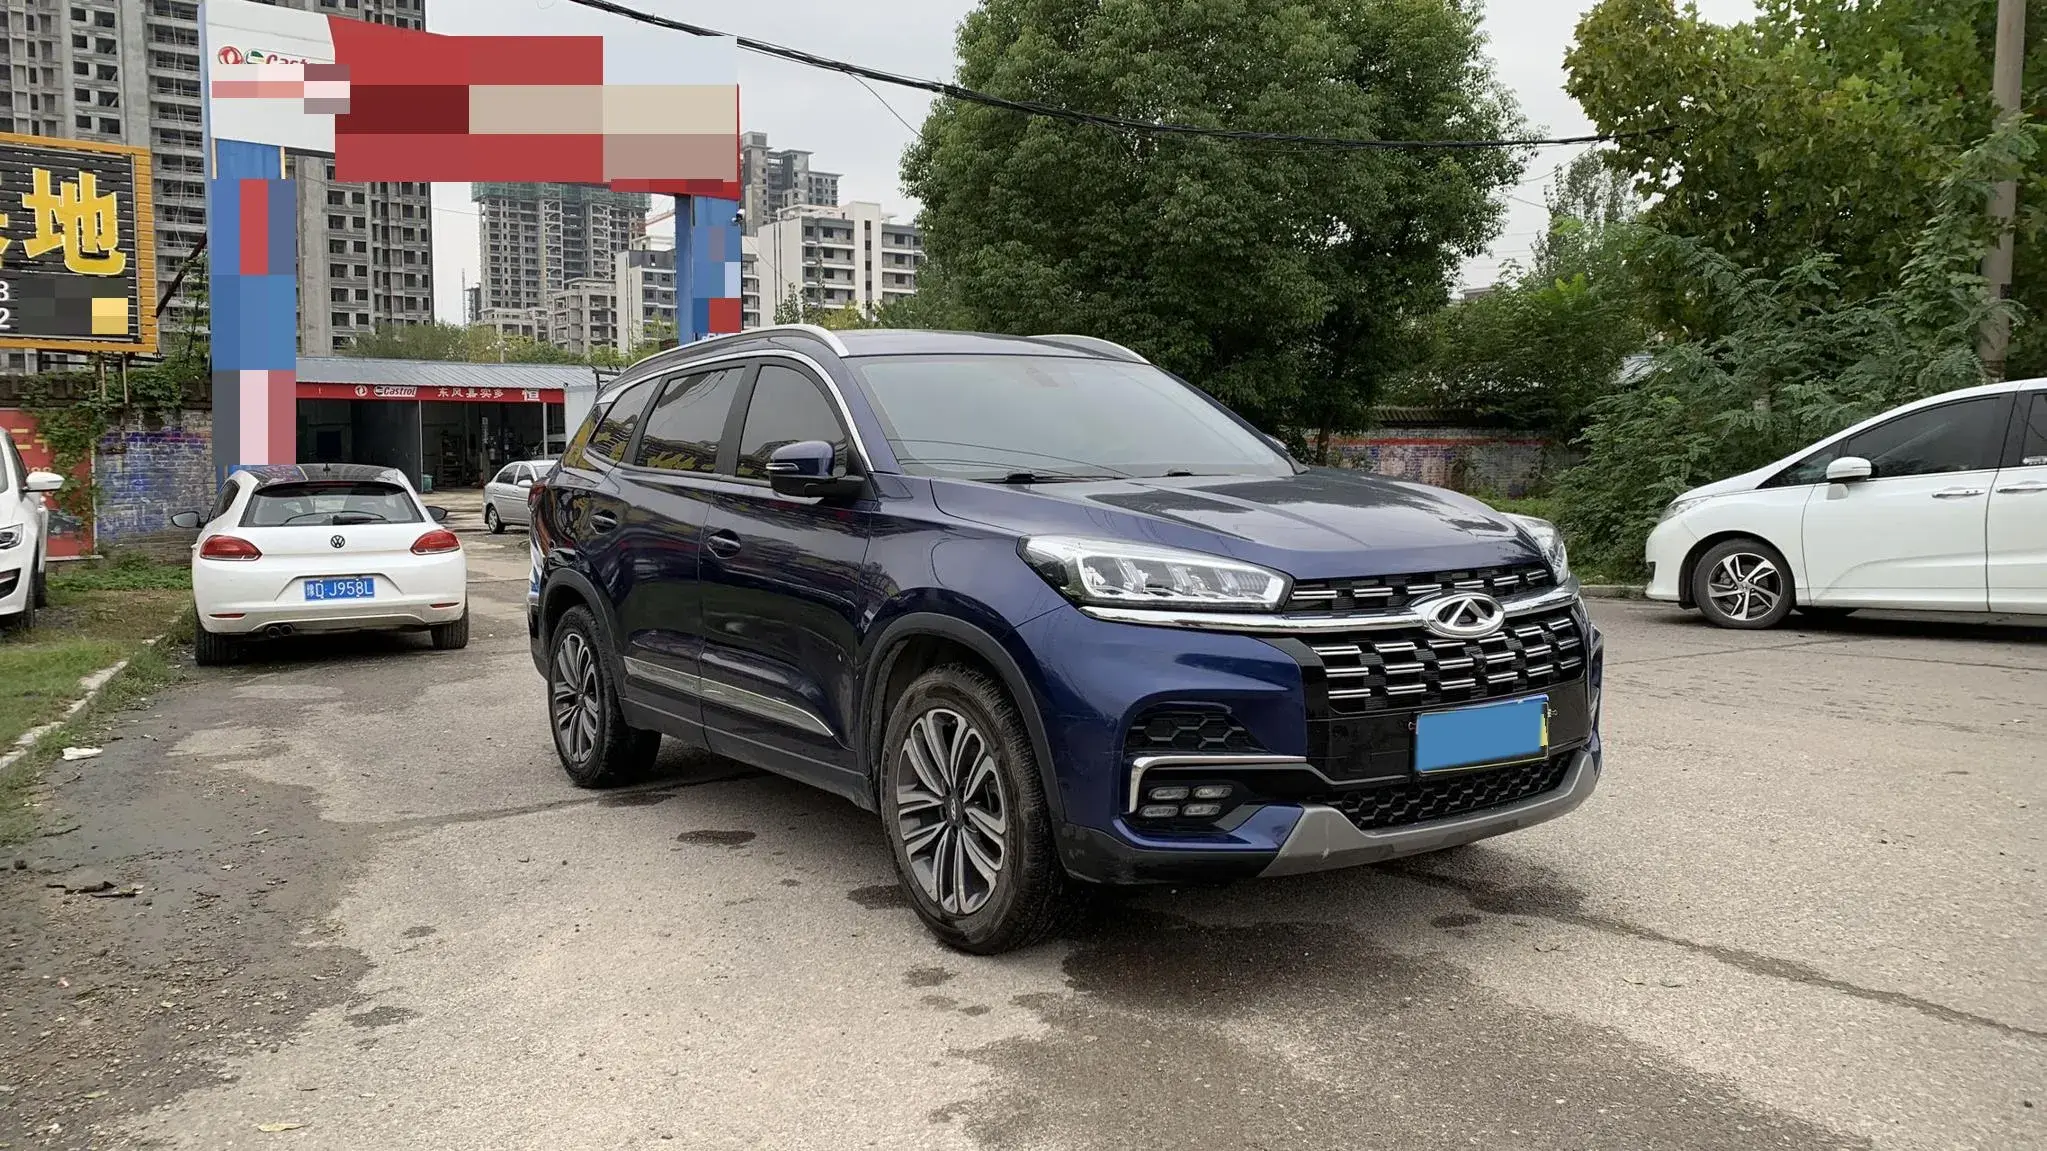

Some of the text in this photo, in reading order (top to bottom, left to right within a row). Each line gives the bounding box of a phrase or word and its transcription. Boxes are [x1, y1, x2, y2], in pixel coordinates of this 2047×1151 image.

[0, 167, 126, 275] 地
[383, 386, 417, 397] Castrol
[437, 387, 504, 399] 东风嘉实多
